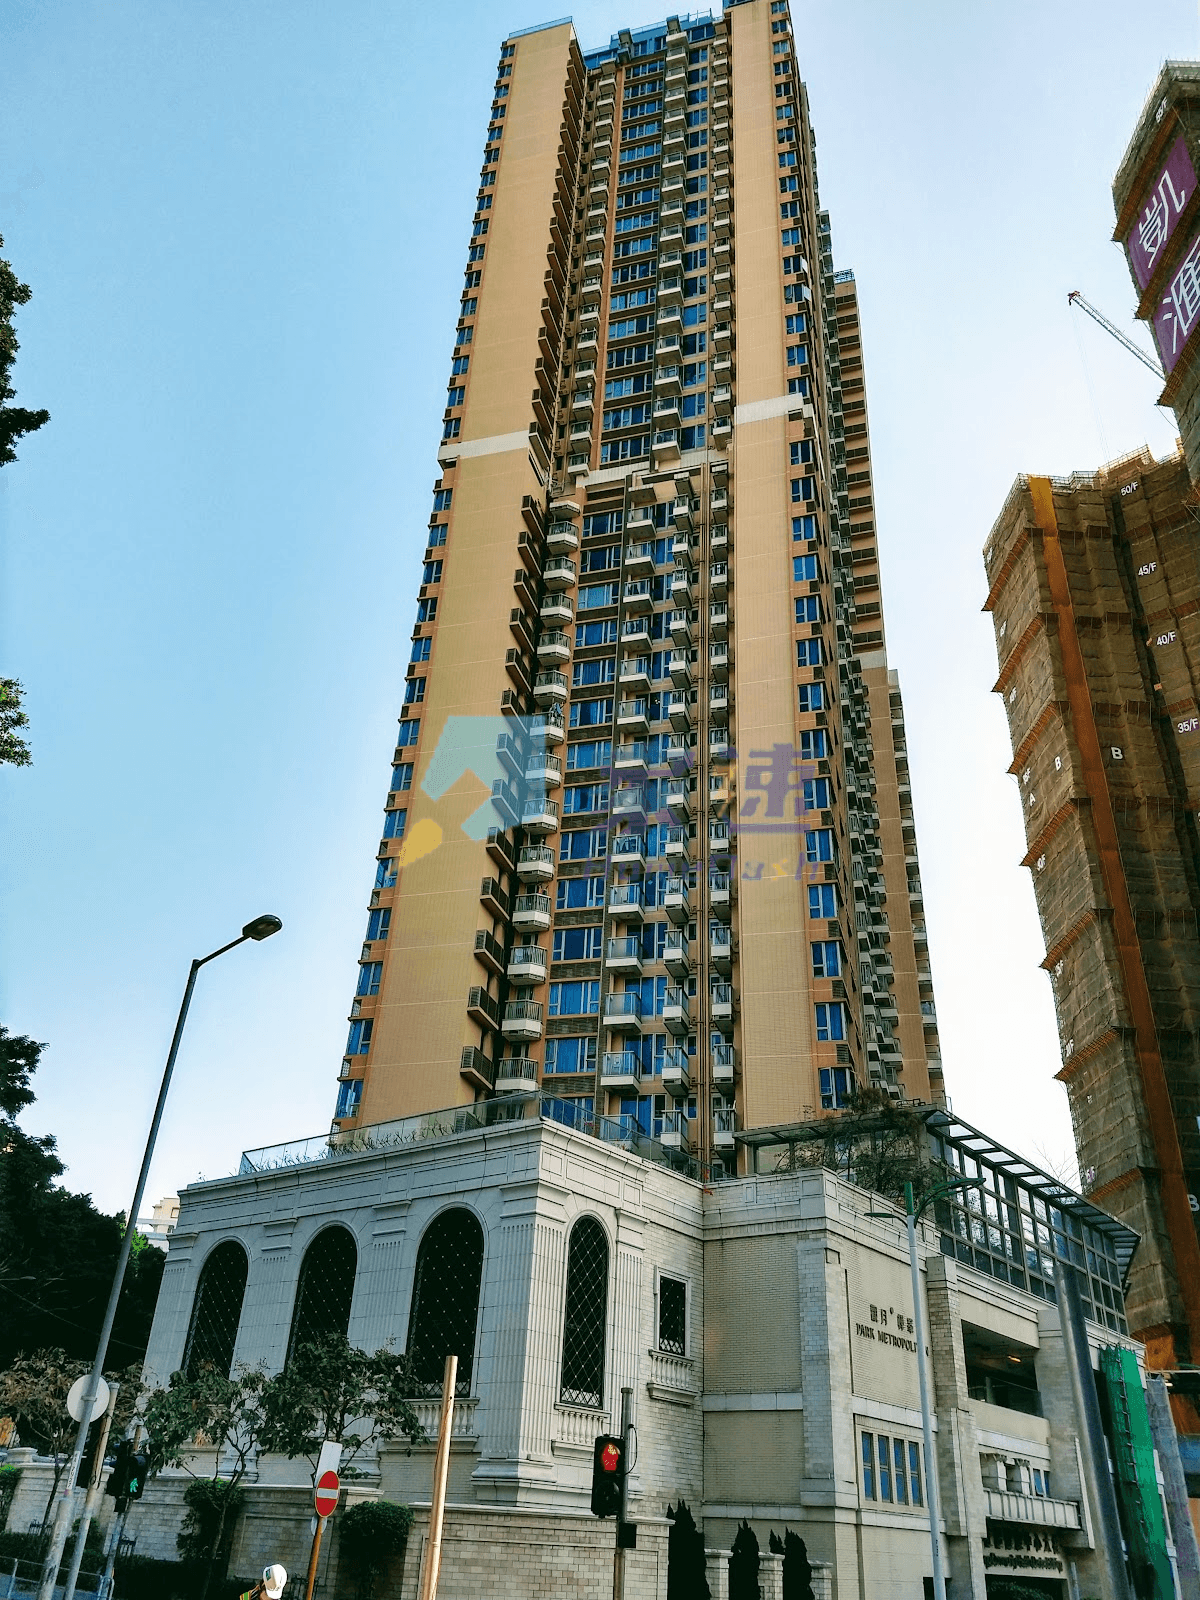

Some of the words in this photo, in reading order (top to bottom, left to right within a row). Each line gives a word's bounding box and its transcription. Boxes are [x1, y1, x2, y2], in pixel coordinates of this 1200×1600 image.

[1120, 481, 1139, 496] 50/F
[1137, 561, 1157, 576] 45/F
[1156, 631, 1177, 646] 40/F
[1177, 718, 1199, 733] 35/F
[1110, 746, 1123, 760] B
[855, 1322, 875, 1340] PARK
